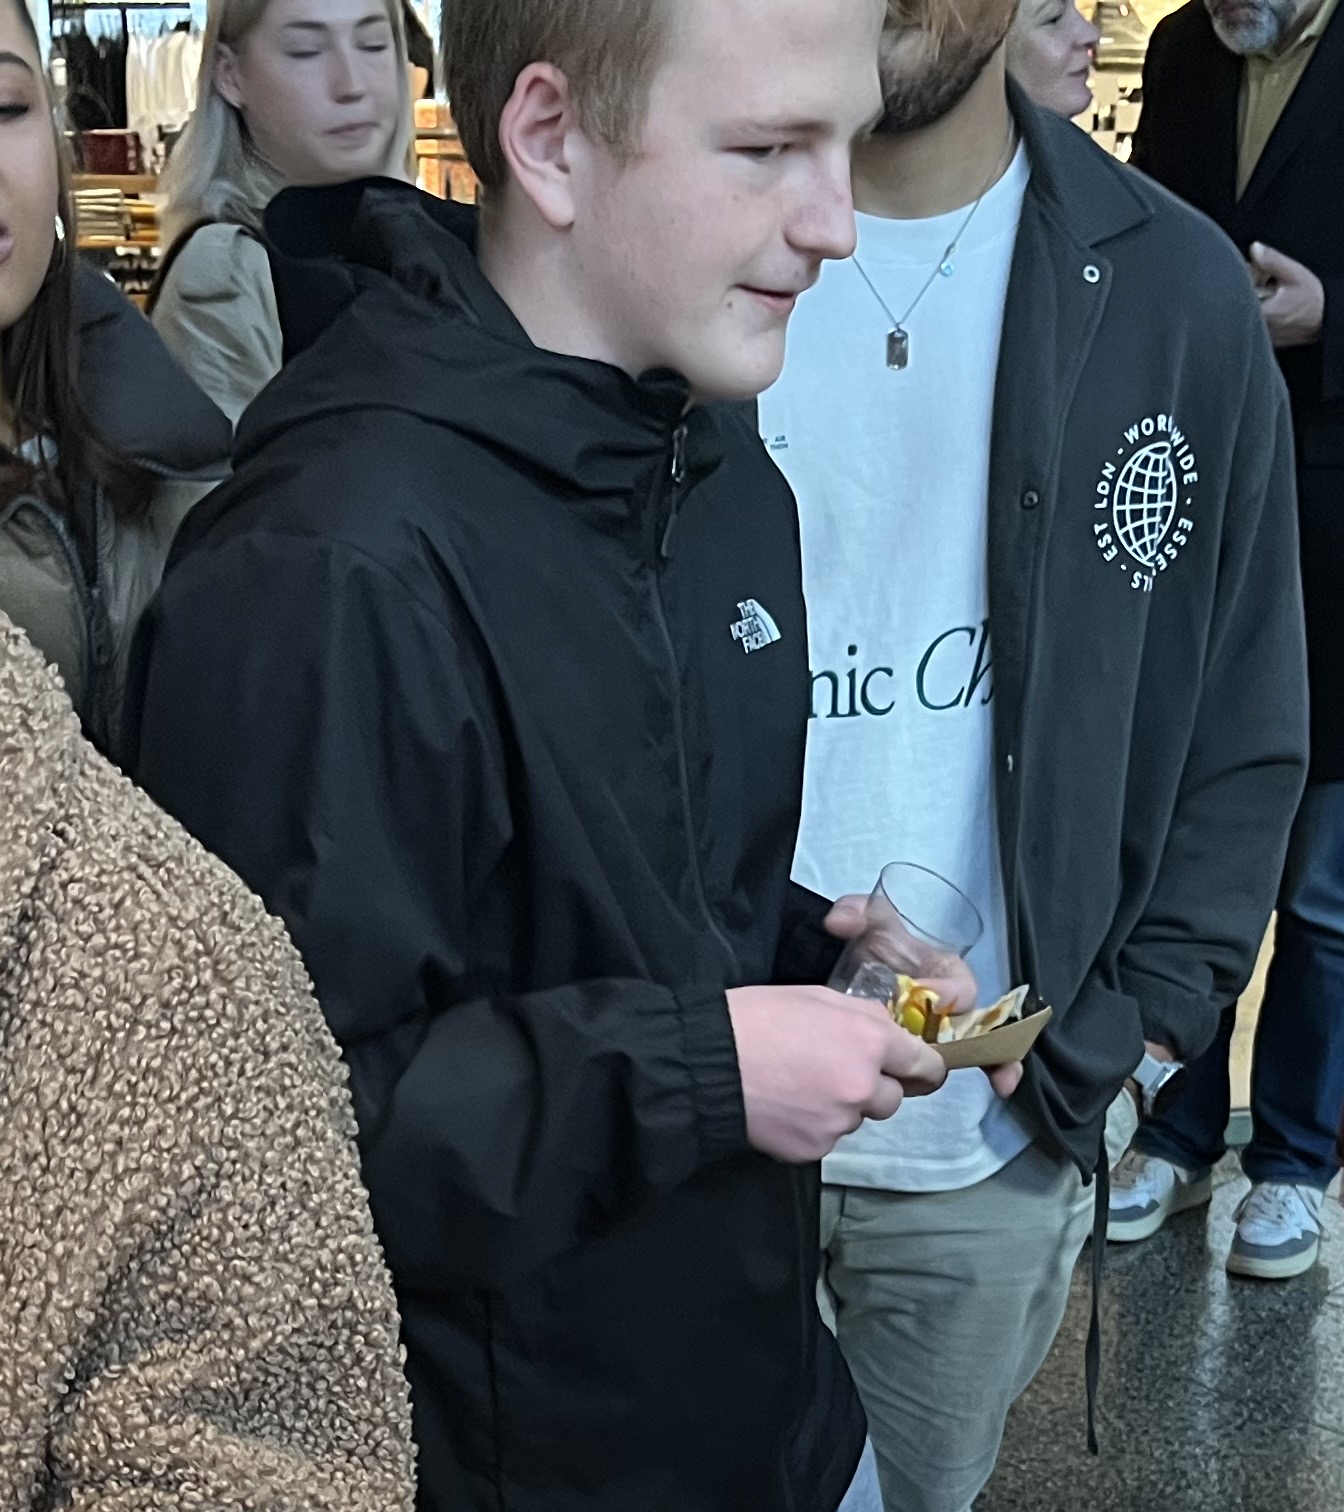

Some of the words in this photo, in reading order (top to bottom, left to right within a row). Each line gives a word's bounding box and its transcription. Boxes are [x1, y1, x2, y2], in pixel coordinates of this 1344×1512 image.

[1123, 414, 1198, 484] WORWIDE
[1094, 462, 1115, 508] LDN
[1093, 523, 1118, 561] EST
[736, 600, 756, 618] THE
